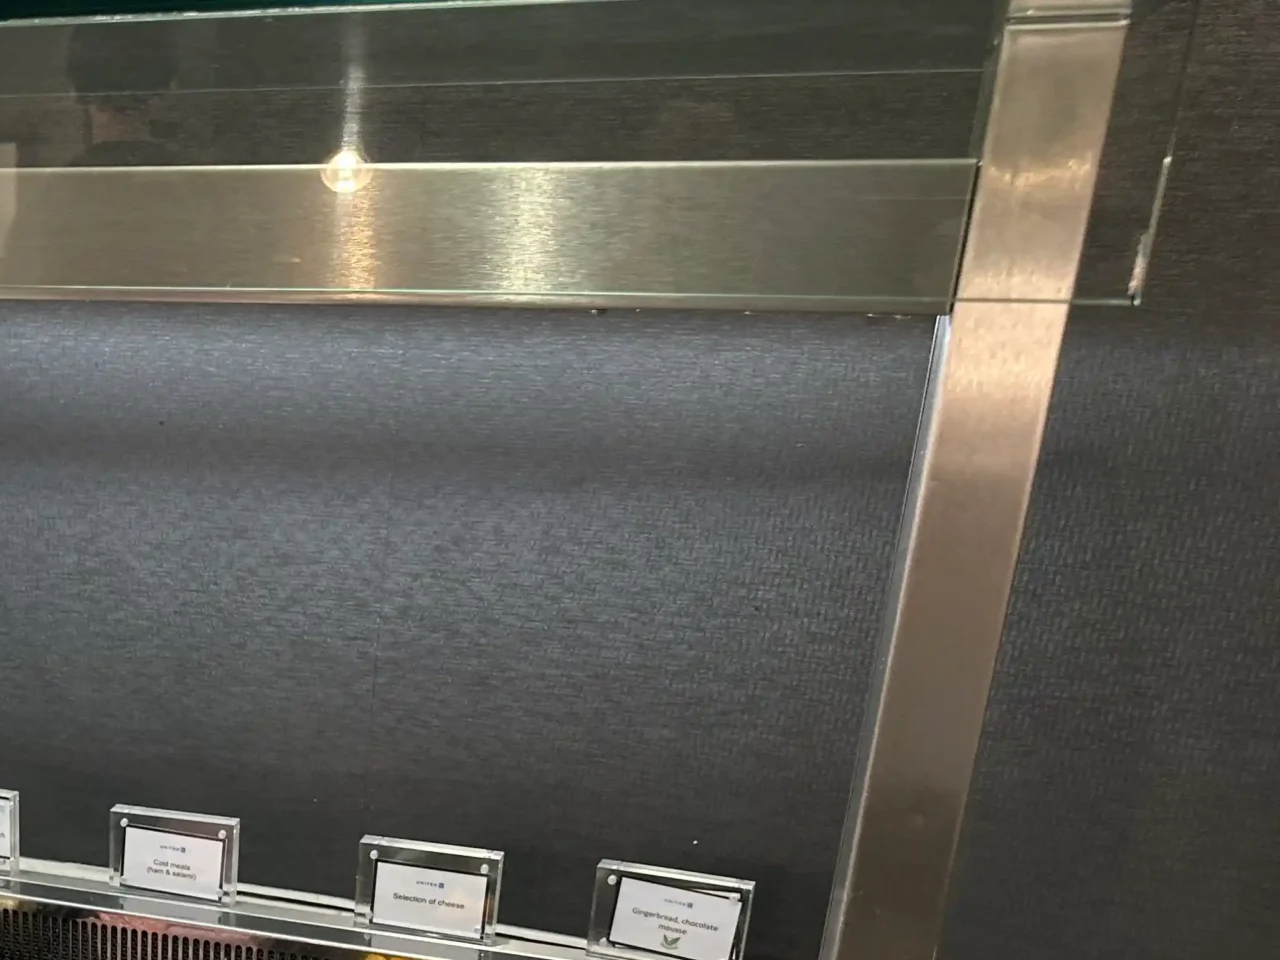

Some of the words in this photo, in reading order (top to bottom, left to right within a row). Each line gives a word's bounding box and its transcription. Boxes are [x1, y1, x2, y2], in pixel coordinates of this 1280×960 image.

[153, 858, 169, 867] Cold
[146, 866, 164, 874] (ham
[172, 871, 196, 880] salami)
[392, 892, 427, 904] Selection
[437, 899, 465, 909] cheese
[632, 907, 679, 924] Gingerbread,
[681, 919, 718, 932] chocolate
[658, 924, 688, 935] mousse
